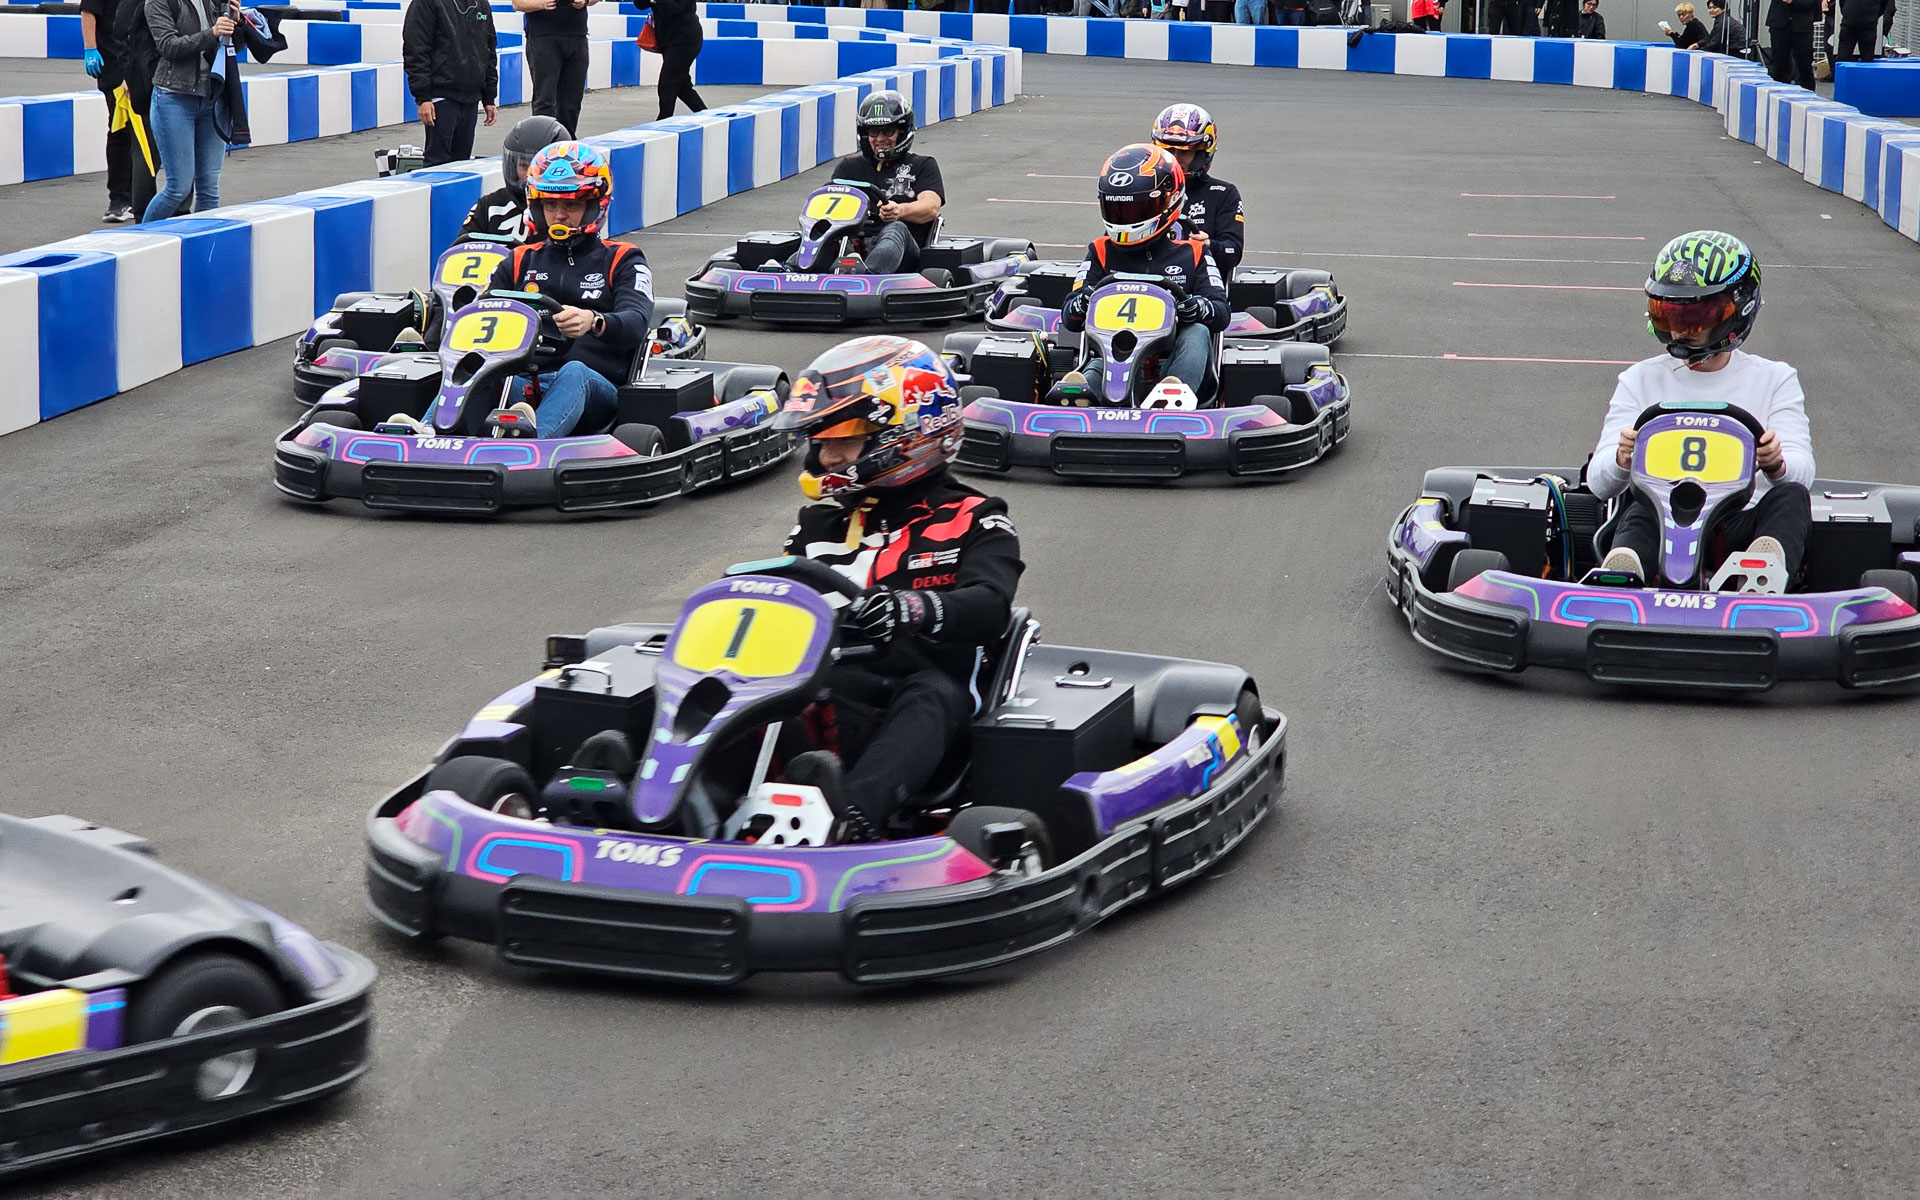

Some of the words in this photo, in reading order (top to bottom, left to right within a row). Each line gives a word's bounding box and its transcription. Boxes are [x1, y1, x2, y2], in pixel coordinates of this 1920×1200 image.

[825, 197, 841, 214] 7
[462, 256, 481, 279] 2
[786, 273, 818, 282] TOM'S
[1116, 284, 1149, 292] TOM'S
[477, 301, 513, 309] TOM'S
[1116, 298, 1137, 323] 4
[473, 316, 498, 344] 3
[1096, 410, 1142, 421] TOM'S
[1675, 416, 1720, 428] TOM'S
[416, 438, 464, 450] TOM'S
[1681, 436, 1707, 472] 8
[729, 580, 792, 596] TOM'S
[1653, 593, 1718, 610] TOM'S
[725, 607, 756, 659] 1
[594, 839, 685, 868] TOM'S
